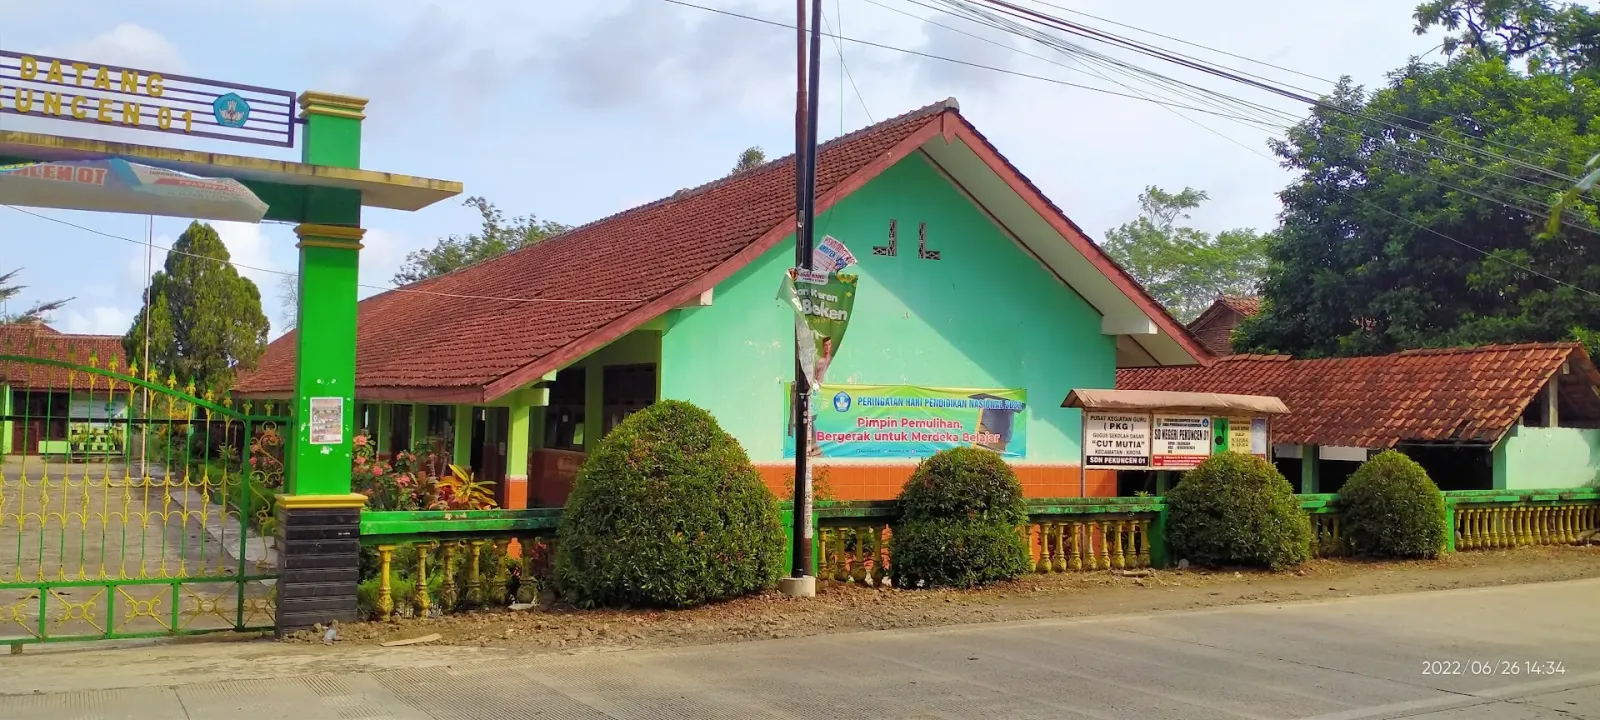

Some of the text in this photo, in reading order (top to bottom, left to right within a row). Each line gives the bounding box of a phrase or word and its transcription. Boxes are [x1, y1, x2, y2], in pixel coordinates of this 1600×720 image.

[20, 55, 165, 97] DATANG
[0, 84, 194, 134] UNCEN 01
[811, 288, 838, 302] Keren
[802, 298, 848, 320] Beken
[857, 397, 903, 407] PERINGATAN
[905, 398, 923, 408] HARI
[925, 398, 967, 408] PENDIDIKAN
[969, 399, 1003, 410] NASIONAL
[857, 417, 963, 430] Pimpin Pemulihan,
[815, 431, 1001, 444] Bergerak untuk Merdeka Belajar
[1154, 428, 1161, 440] SD
[1161, 429, 1179, 440] NEGERI
